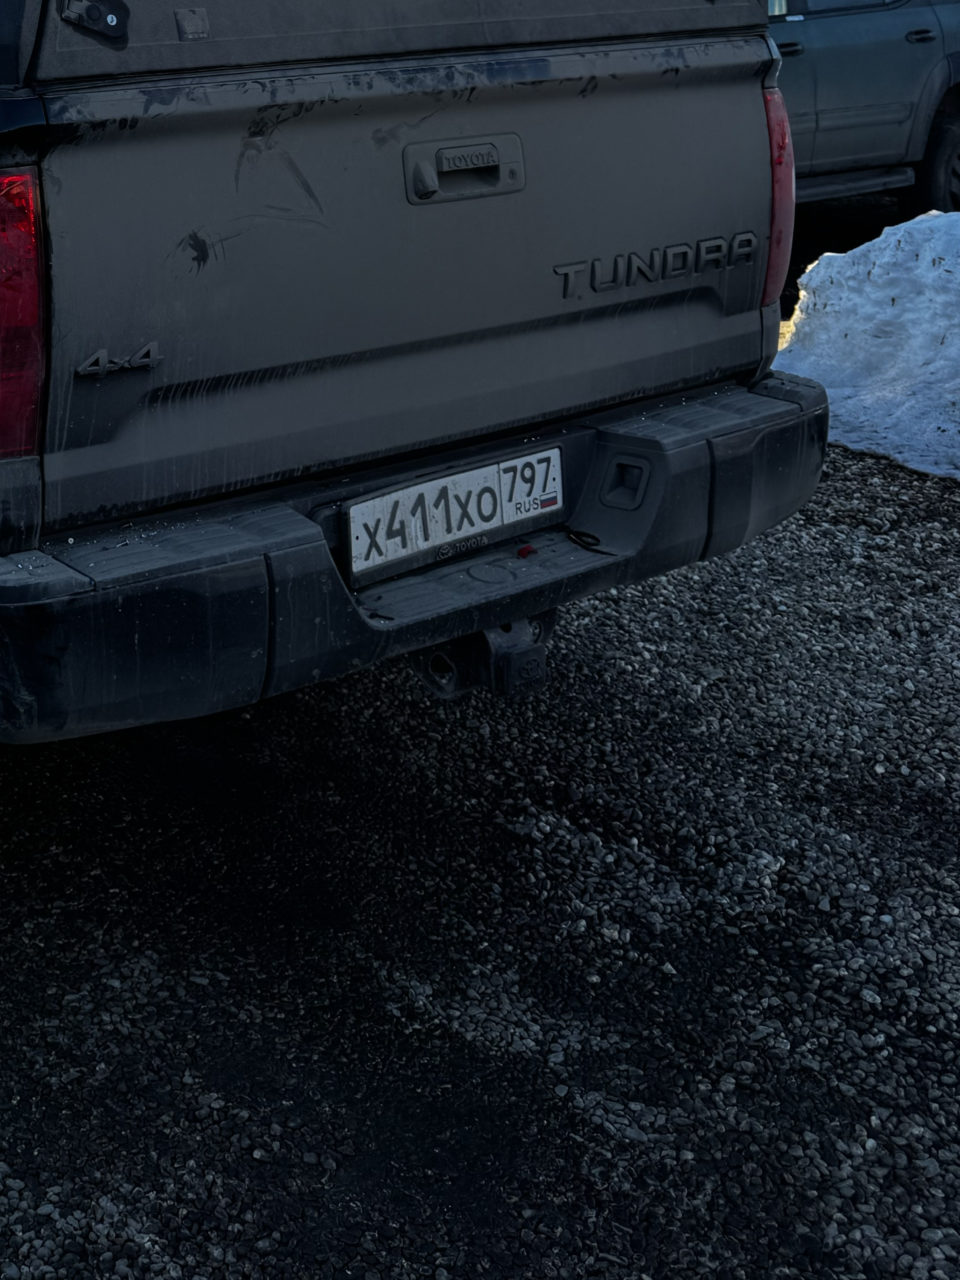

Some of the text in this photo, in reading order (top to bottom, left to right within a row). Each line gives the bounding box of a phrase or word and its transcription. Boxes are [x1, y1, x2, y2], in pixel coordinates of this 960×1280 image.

[444, 151, 496, 169] TOYOTA
[553, 231, 757, 299] TUNDRA
[502, 456, 552, 503] 797
[515, 498, 539, 515] RUS
[455, 535, 489, 553] TOYOTA
